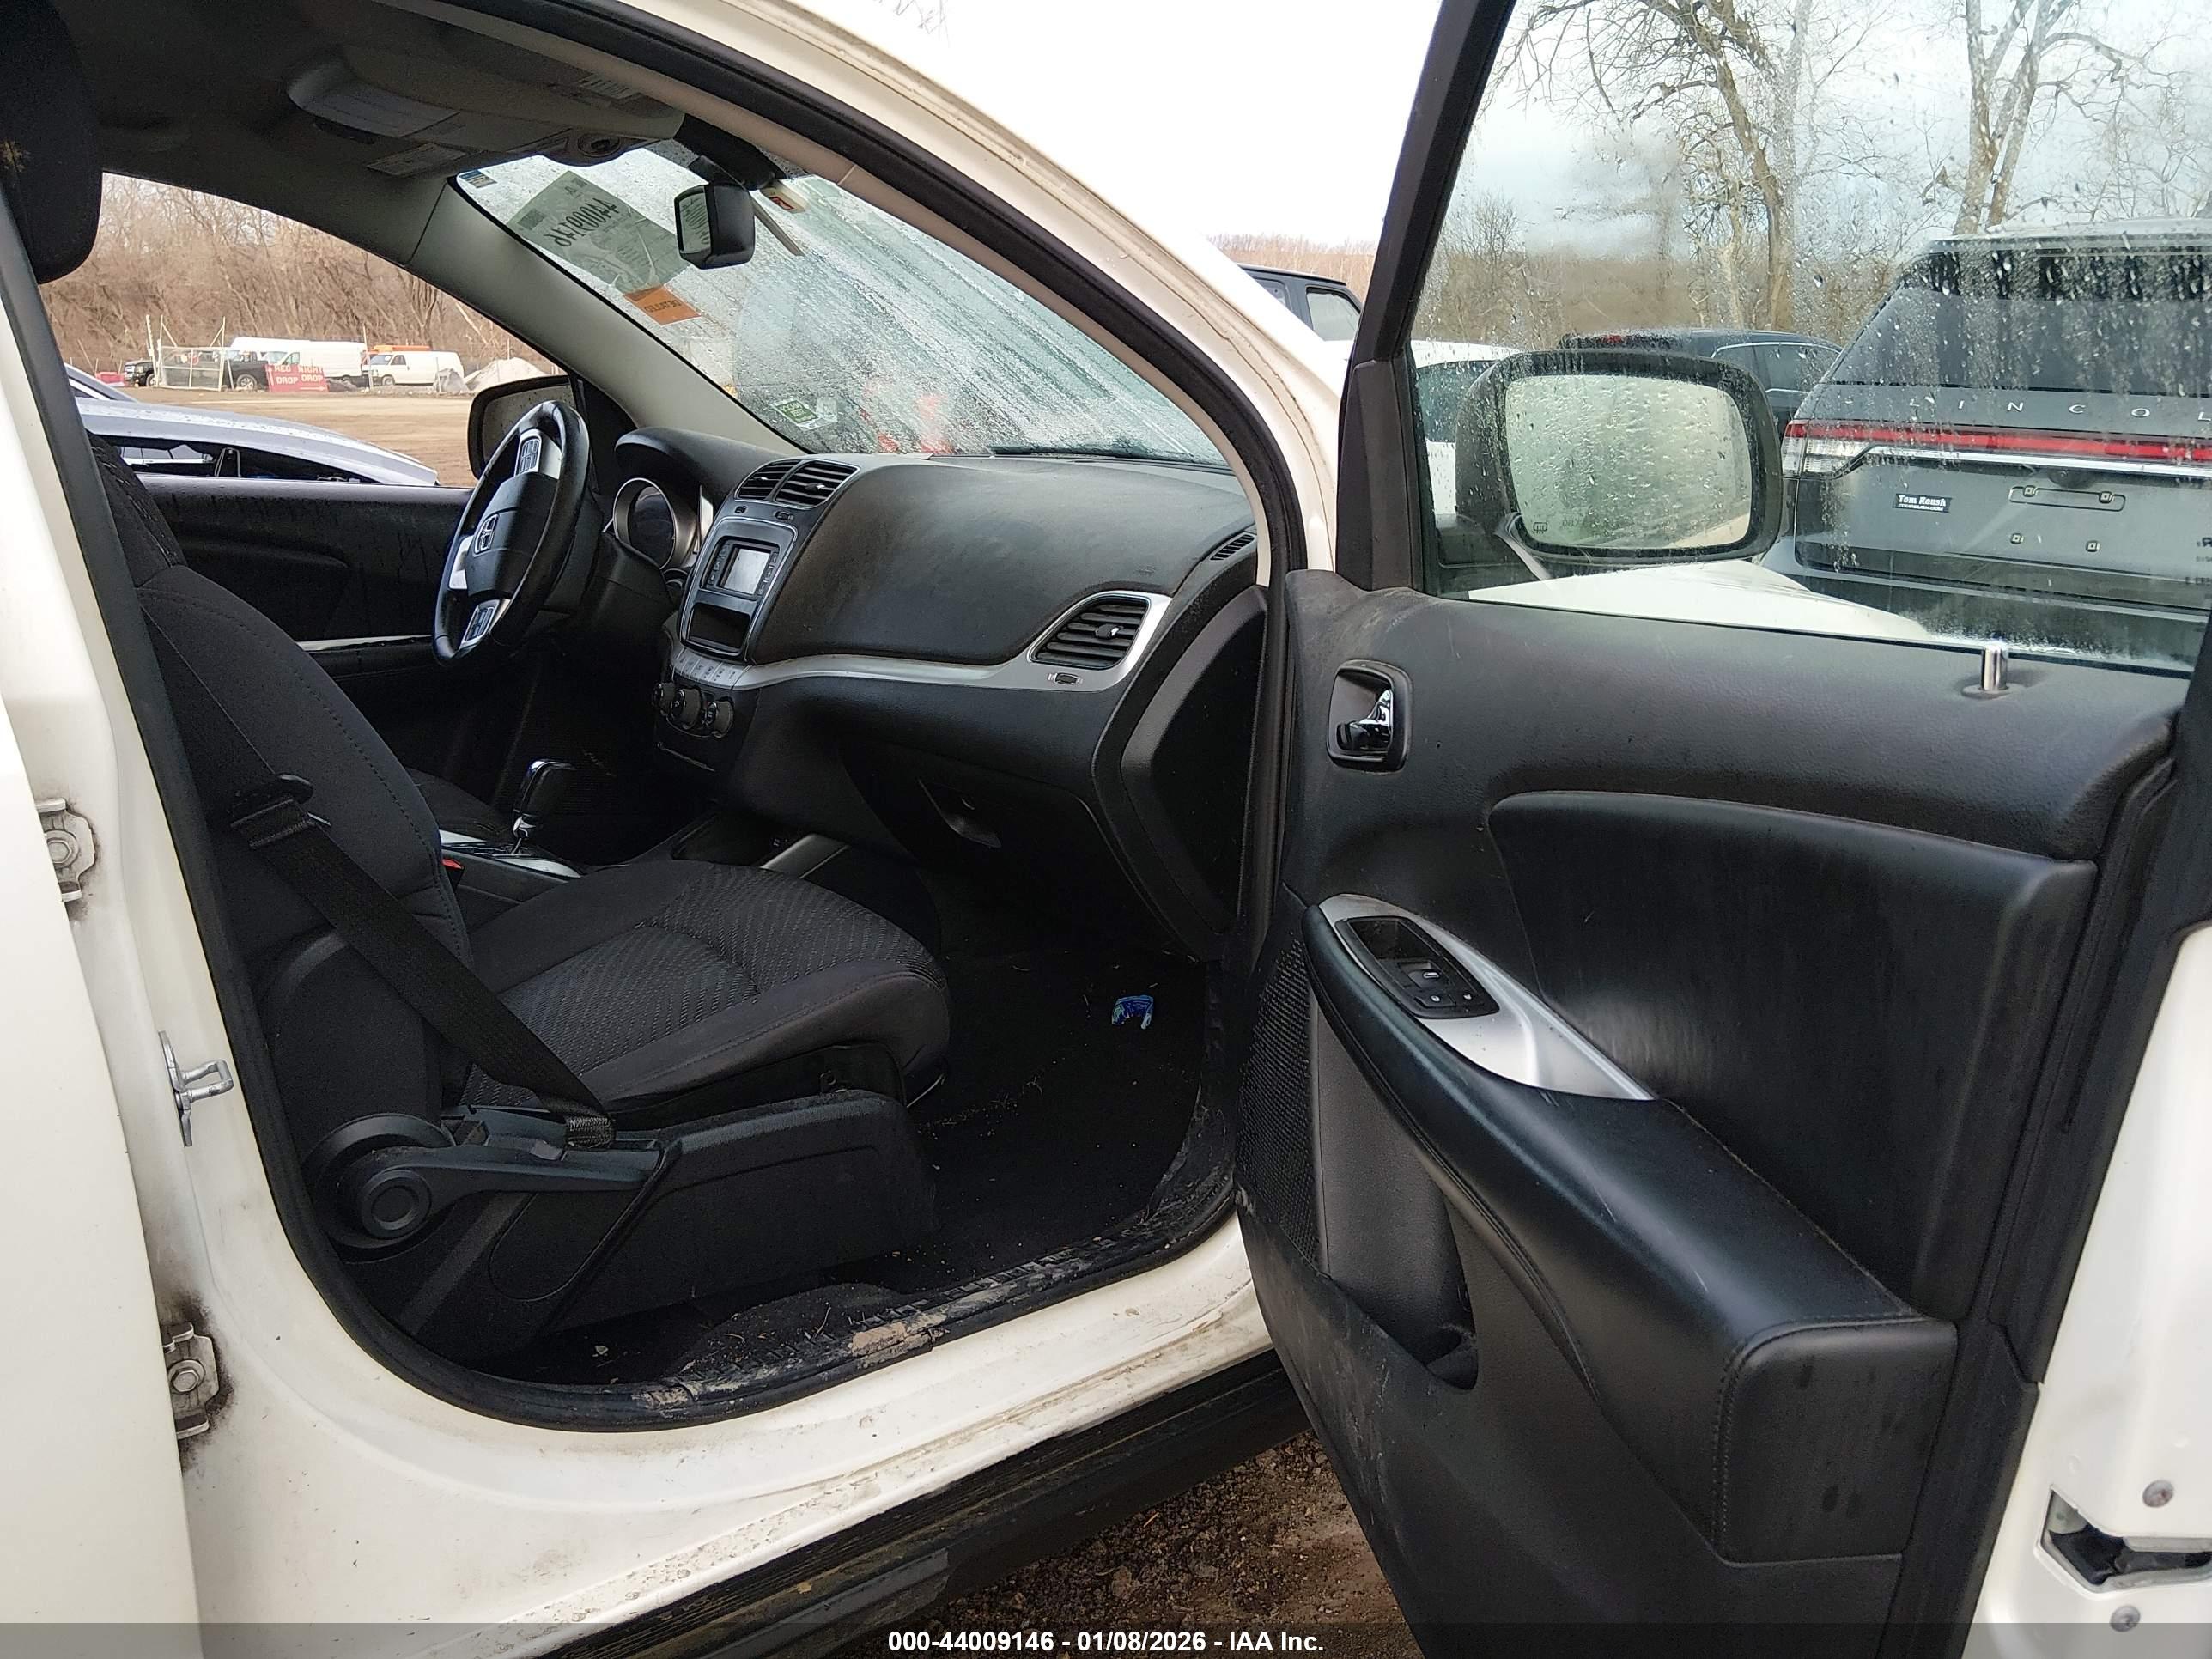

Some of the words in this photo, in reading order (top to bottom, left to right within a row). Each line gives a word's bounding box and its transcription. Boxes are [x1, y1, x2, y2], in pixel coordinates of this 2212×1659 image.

[276, 376, 298, 385] DROP
[1898, 495, 1917, 504] Tom
[1918, 495, 1947, 507] Roush
